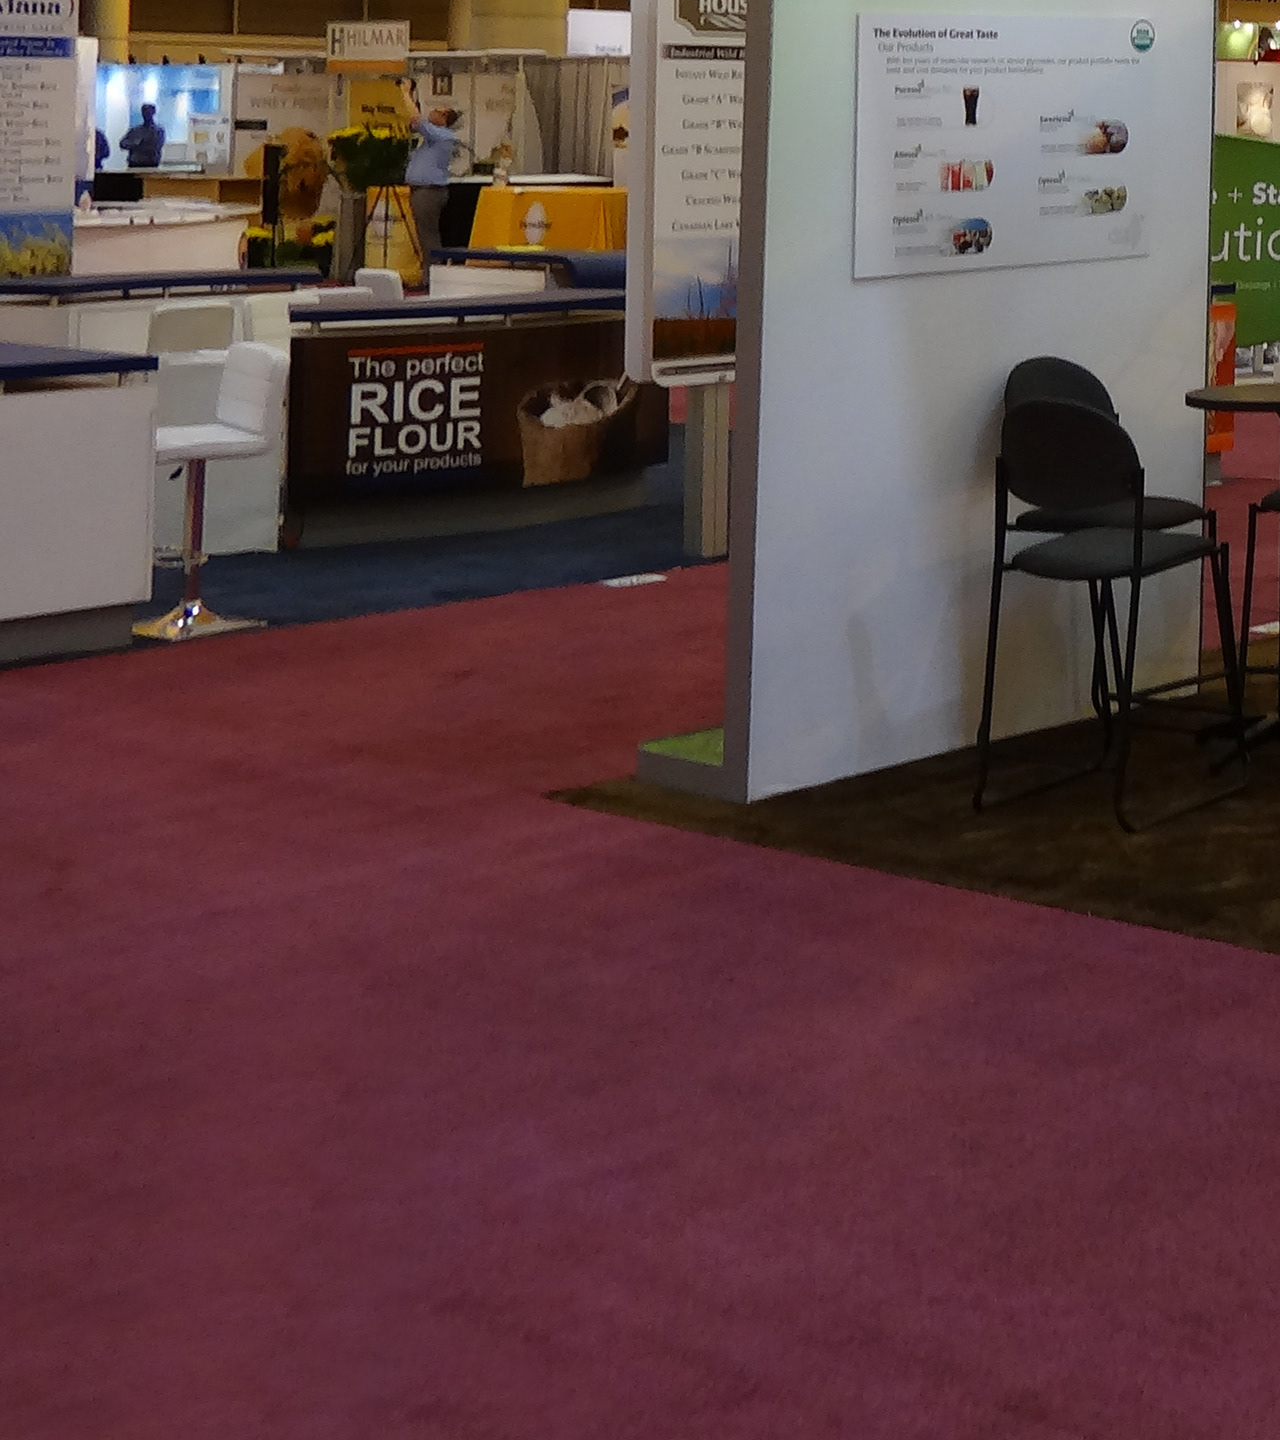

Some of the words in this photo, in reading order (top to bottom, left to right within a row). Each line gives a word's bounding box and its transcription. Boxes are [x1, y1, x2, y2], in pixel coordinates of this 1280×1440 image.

[873, 27, 890, 40] The
[892, 27, 936, 40] Evolution
[937, 27, 948, 40] of
[949, 28, 974, 40] Great
[975, 28, 999, 40] Taste
[348, 355, 397, 380] The
[405, 351, 484, 381] perfect
[350, 375, 482, 426] RICE
[348, 419, 483, 459] FLOUR
[345, 460, 370, 476] for
[371, 458, 410, 479] your
[413, 452, 483, 476] products
